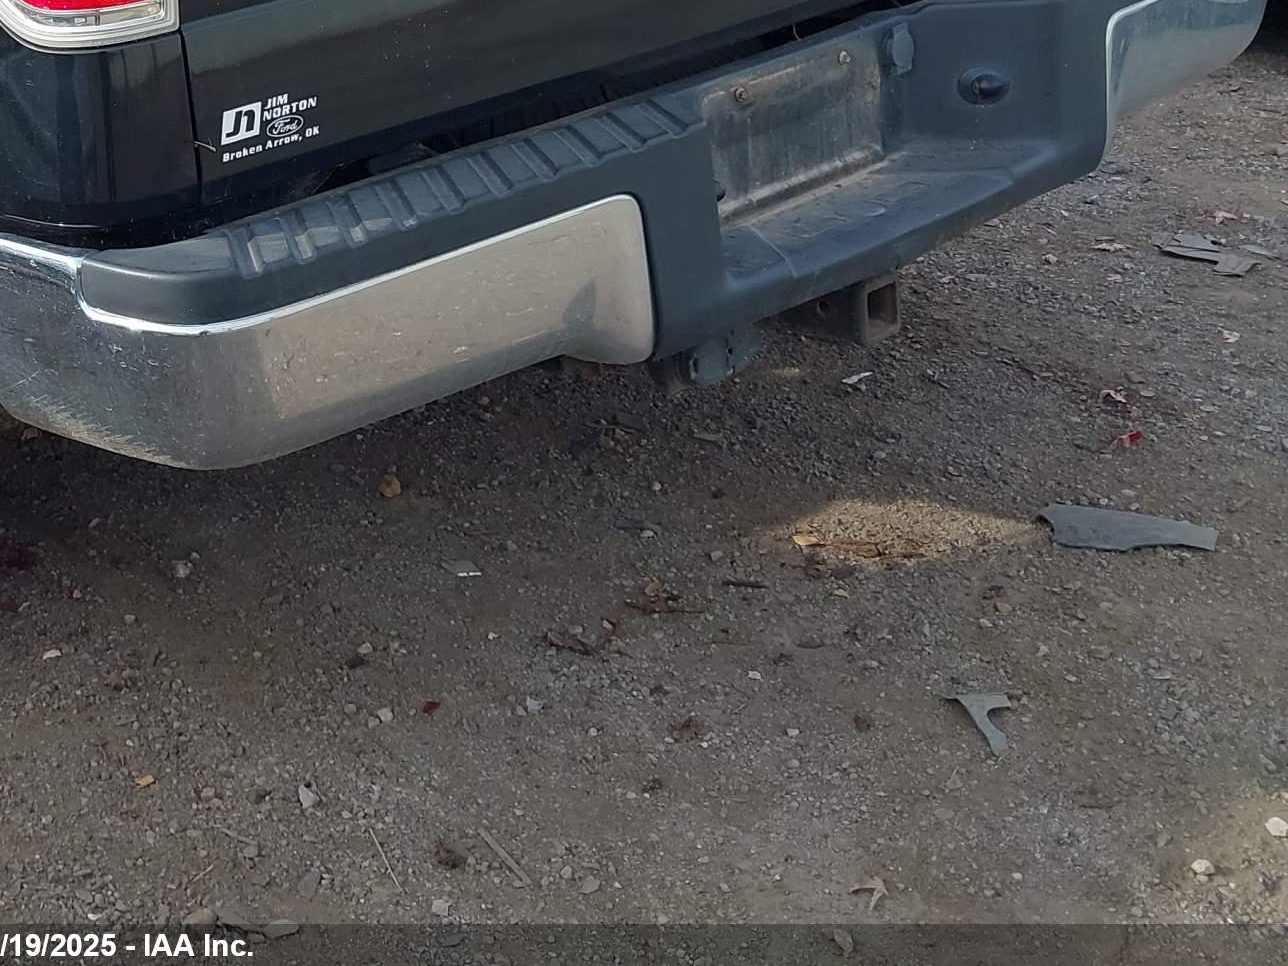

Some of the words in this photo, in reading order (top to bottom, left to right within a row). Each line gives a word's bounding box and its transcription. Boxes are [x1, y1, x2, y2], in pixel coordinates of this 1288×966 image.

[262, 96, 318, 122] NORTON
[264, 93, 289, 110] JIM
[270, 118, 300, 135] Ford
[222, 144, 263, 163] Broken
[265, 133, 303, 150] Arrow,
[305, 125, 320, 138] OK
